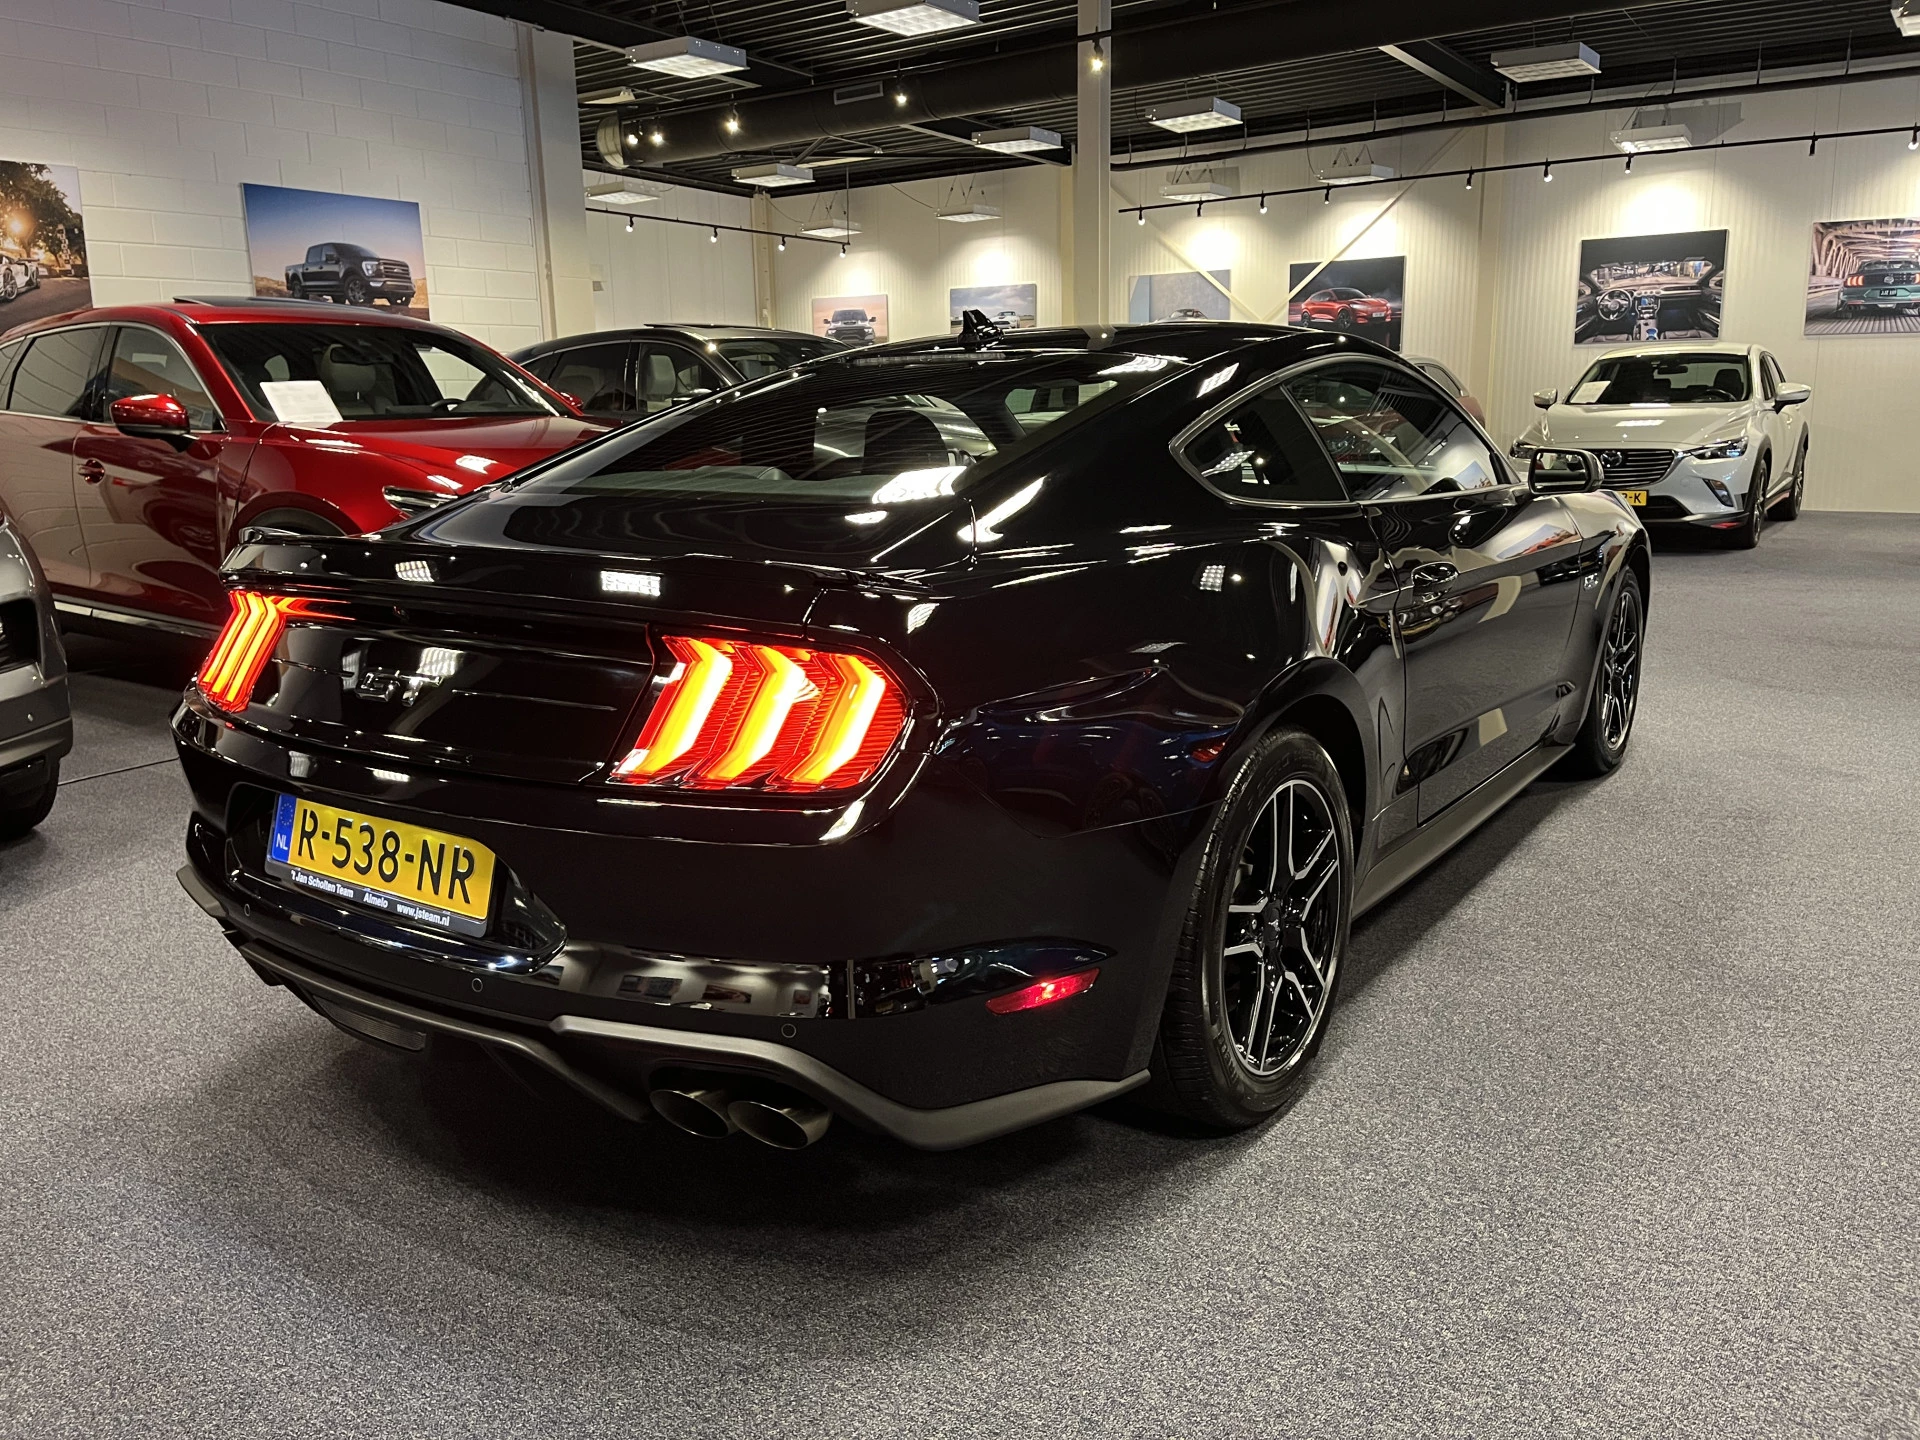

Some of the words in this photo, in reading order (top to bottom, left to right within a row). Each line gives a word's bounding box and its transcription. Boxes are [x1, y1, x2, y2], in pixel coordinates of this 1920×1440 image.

[276, 833, 289, 851] NL
[297, 808, 475, 905] R-538-NR
[296, 871, 308, 884] Jan
[308, 875, 336, 893] Scholten
[336, 883, 354, 898] Team
[363, 892, 389, 909] Almelo
[396, 903, 450, 927] www.jsteam.nl
